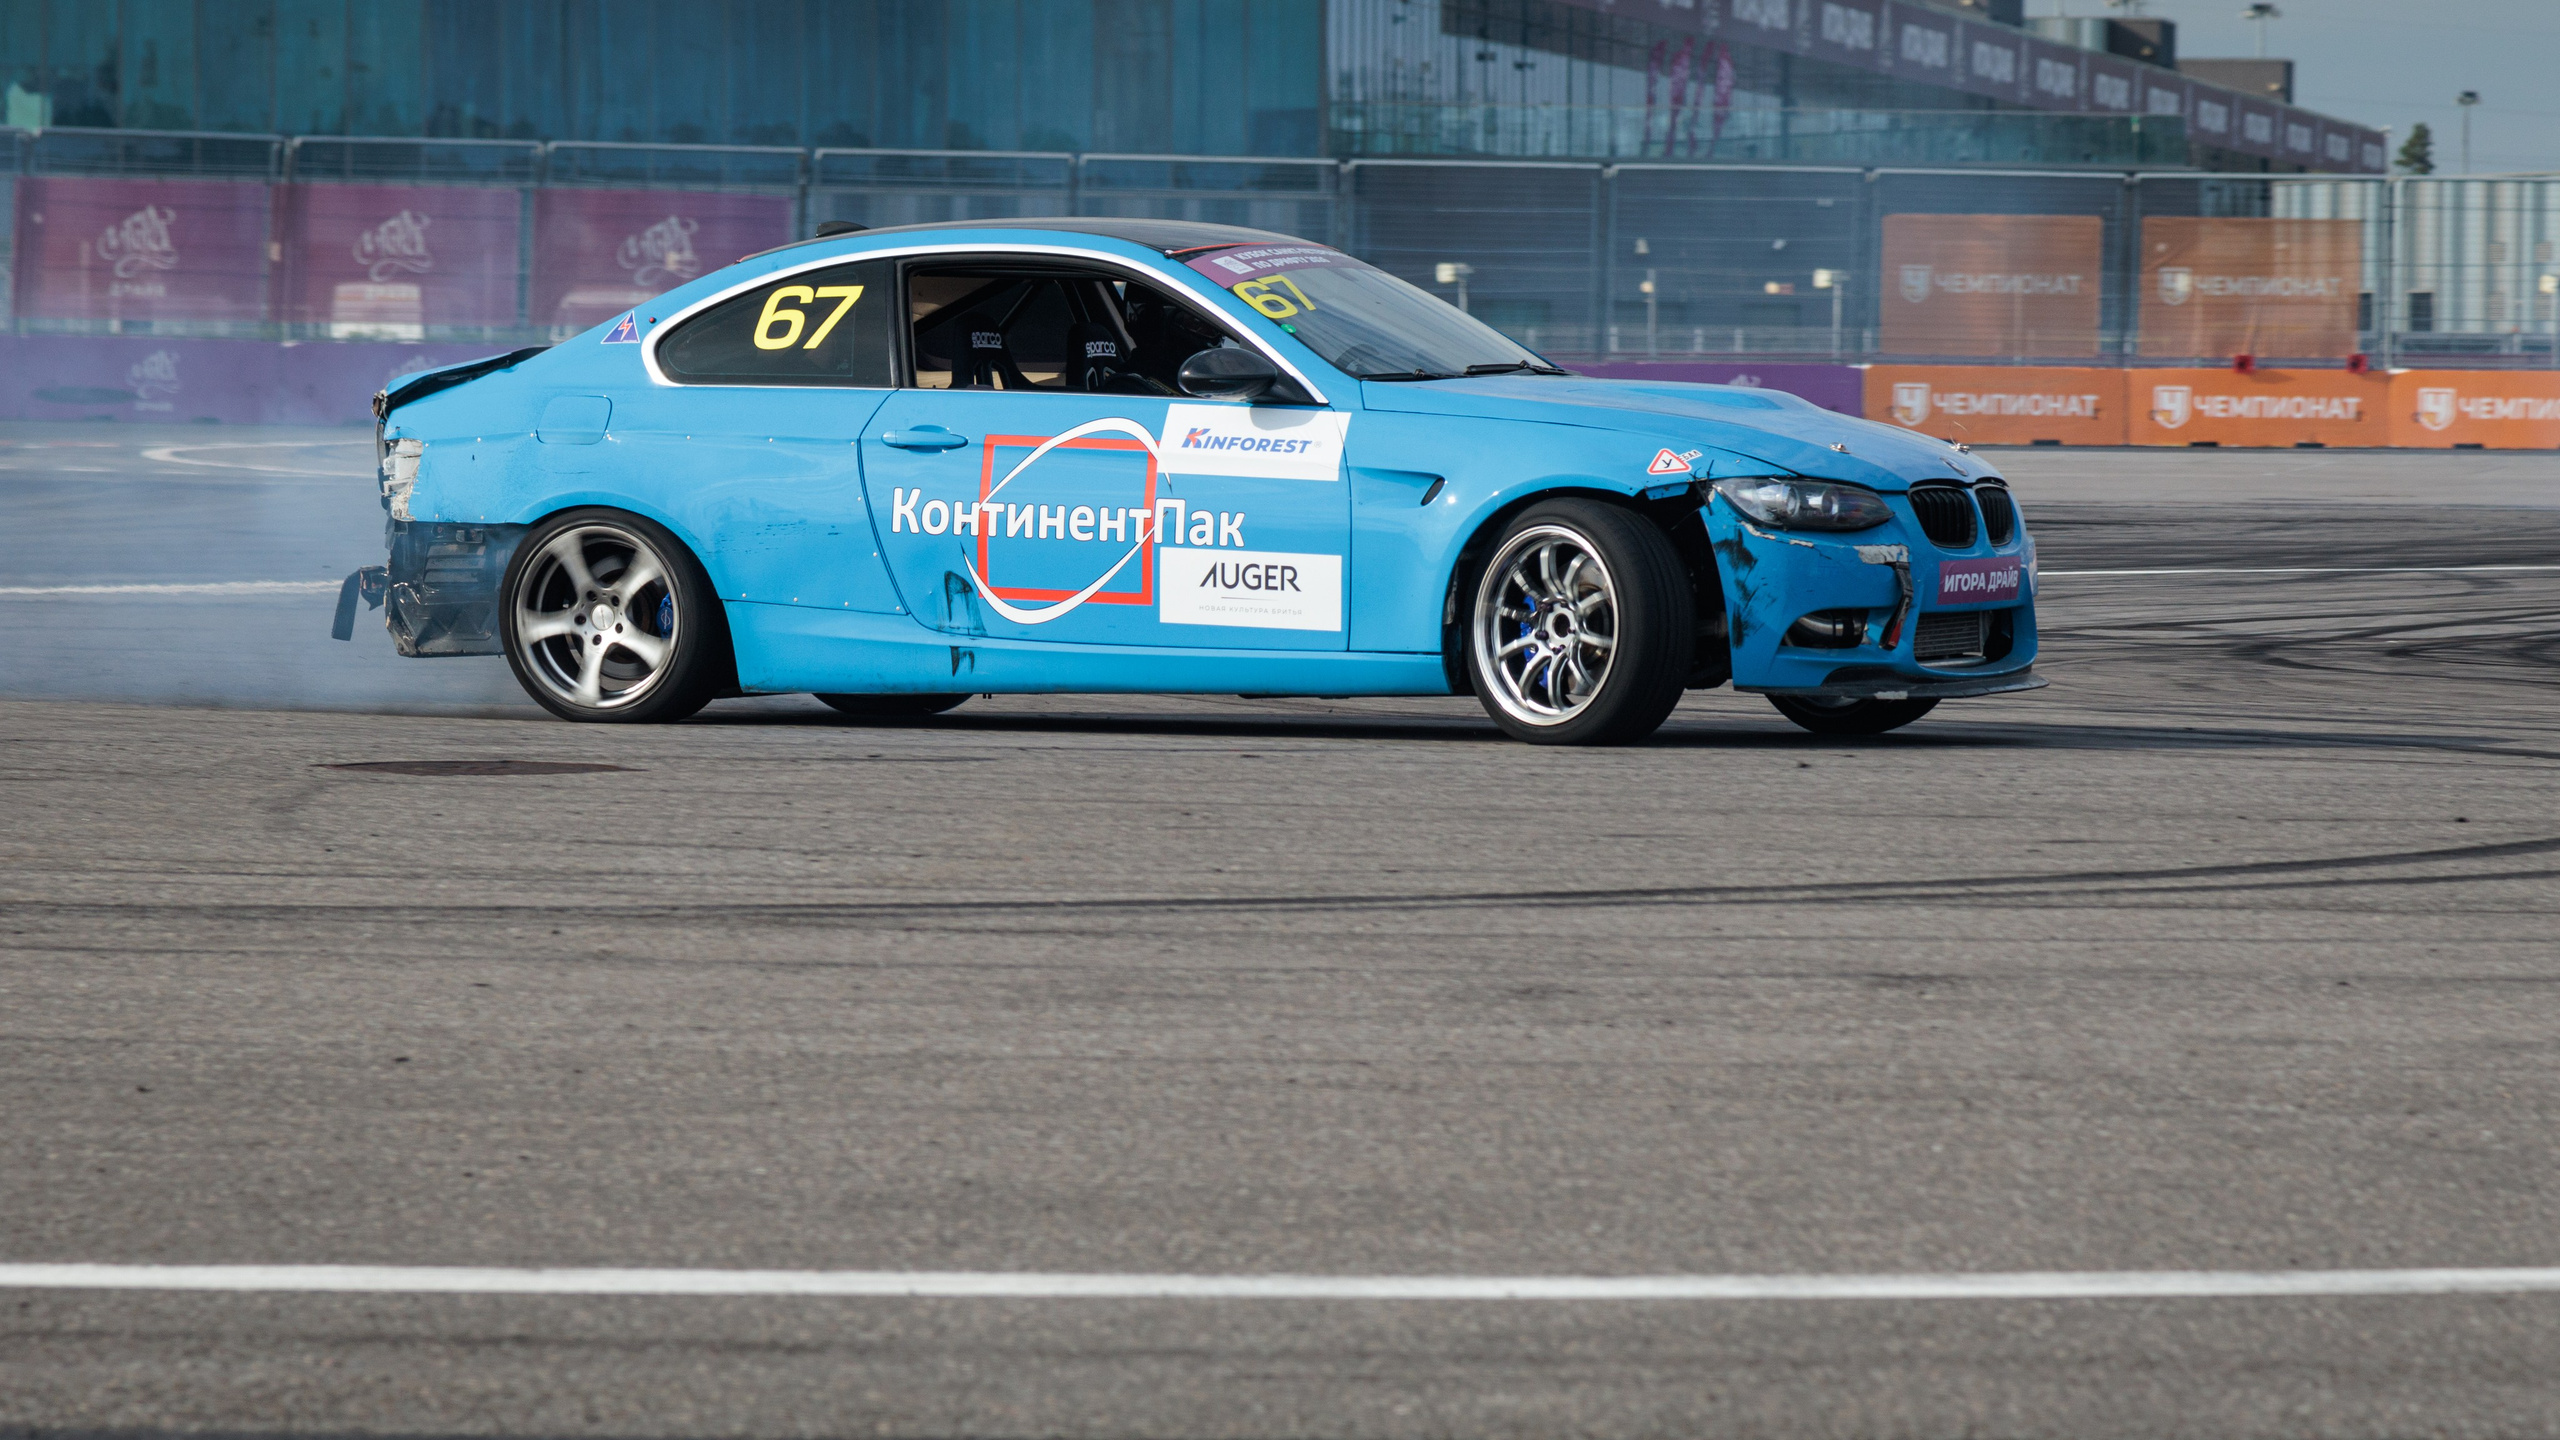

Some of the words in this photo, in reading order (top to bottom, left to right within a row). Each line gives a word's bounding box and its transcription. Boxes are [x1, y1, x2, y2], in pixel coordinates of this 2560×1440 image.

[1935, 273, 2083, 295] ЧЕМПИОНАТ
[2197, 275, 2341, 297] ЧЕМПИОНАТ
[1233, 274, 1317, 319] 67
[753, 285, 864, 350] 67
[972, 331, 1002, 348] sparco
[1085, 340, 1116, 357] sparco
[1933, 393, 2098, 416] ЧЕМПИОНАТ
[2194, 395, 2361, 419] ЧЕМПИОНАТ
[2458, 397, 2560, 419] ЧЕМПИ
[1181, 427, 1313, 454] KINFOREST
[890, 487, 1246, 548] КонтинентПак
[1199, 561, 1302, 592] AUGER
[1944, 572, 1986, 593] ИГОРА
[1987, 565, 2019, 593] ДРАЙВ
[1199, 605, 1226, 613] НОВАЯ
[1229, 606, 1269, 615] КУЛЬТУРА
[1271, 608, 1303, 616] БРИТЬЯ
